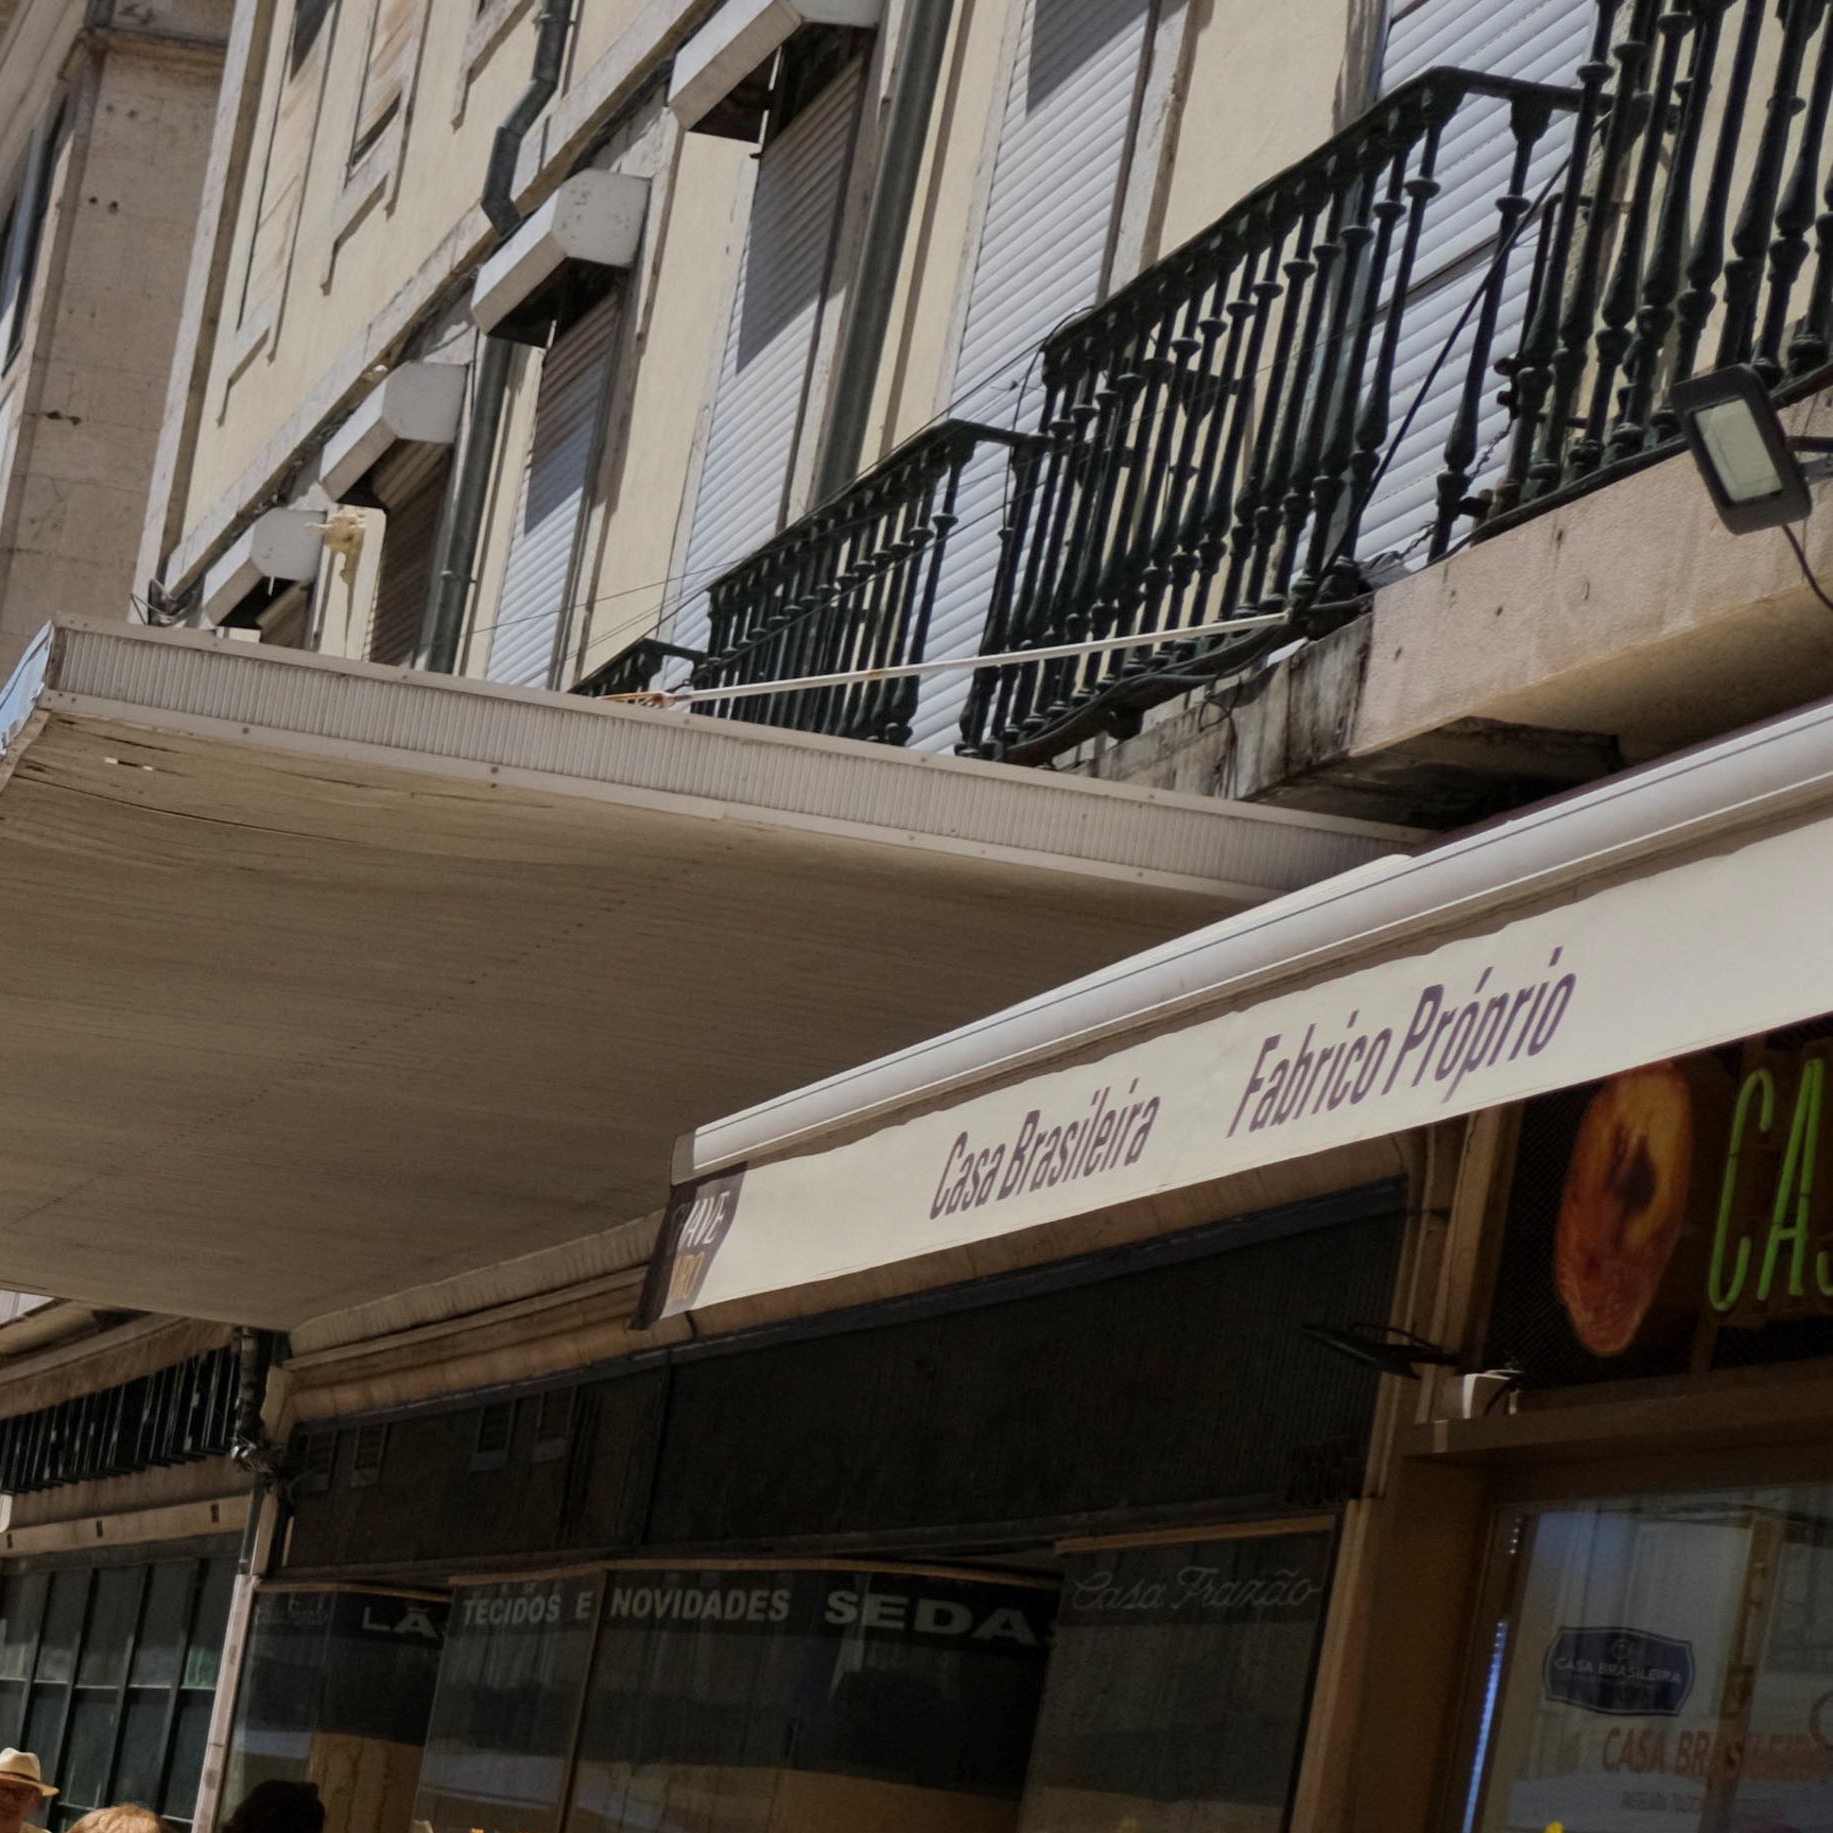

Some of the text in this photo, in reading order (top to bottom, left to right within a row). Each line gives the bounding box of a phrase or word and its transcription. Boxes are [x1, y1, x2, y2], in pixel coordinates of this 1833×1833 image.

[931, 946, 1578, 1220] Casa Brasileira Fabrico Próprio
[1708, 1056, 1833, 1312] CA
[361, 1606, 444, 1640] LÃ
[463, 1591, 594, 1625] TECIDOS E
[609, 1588, 792, 1623] NOVIDADES
[823, 1589, 1051, 1648] SEDA
[1555, 1657, 1682, 1683] CASA BRASILEIRA
